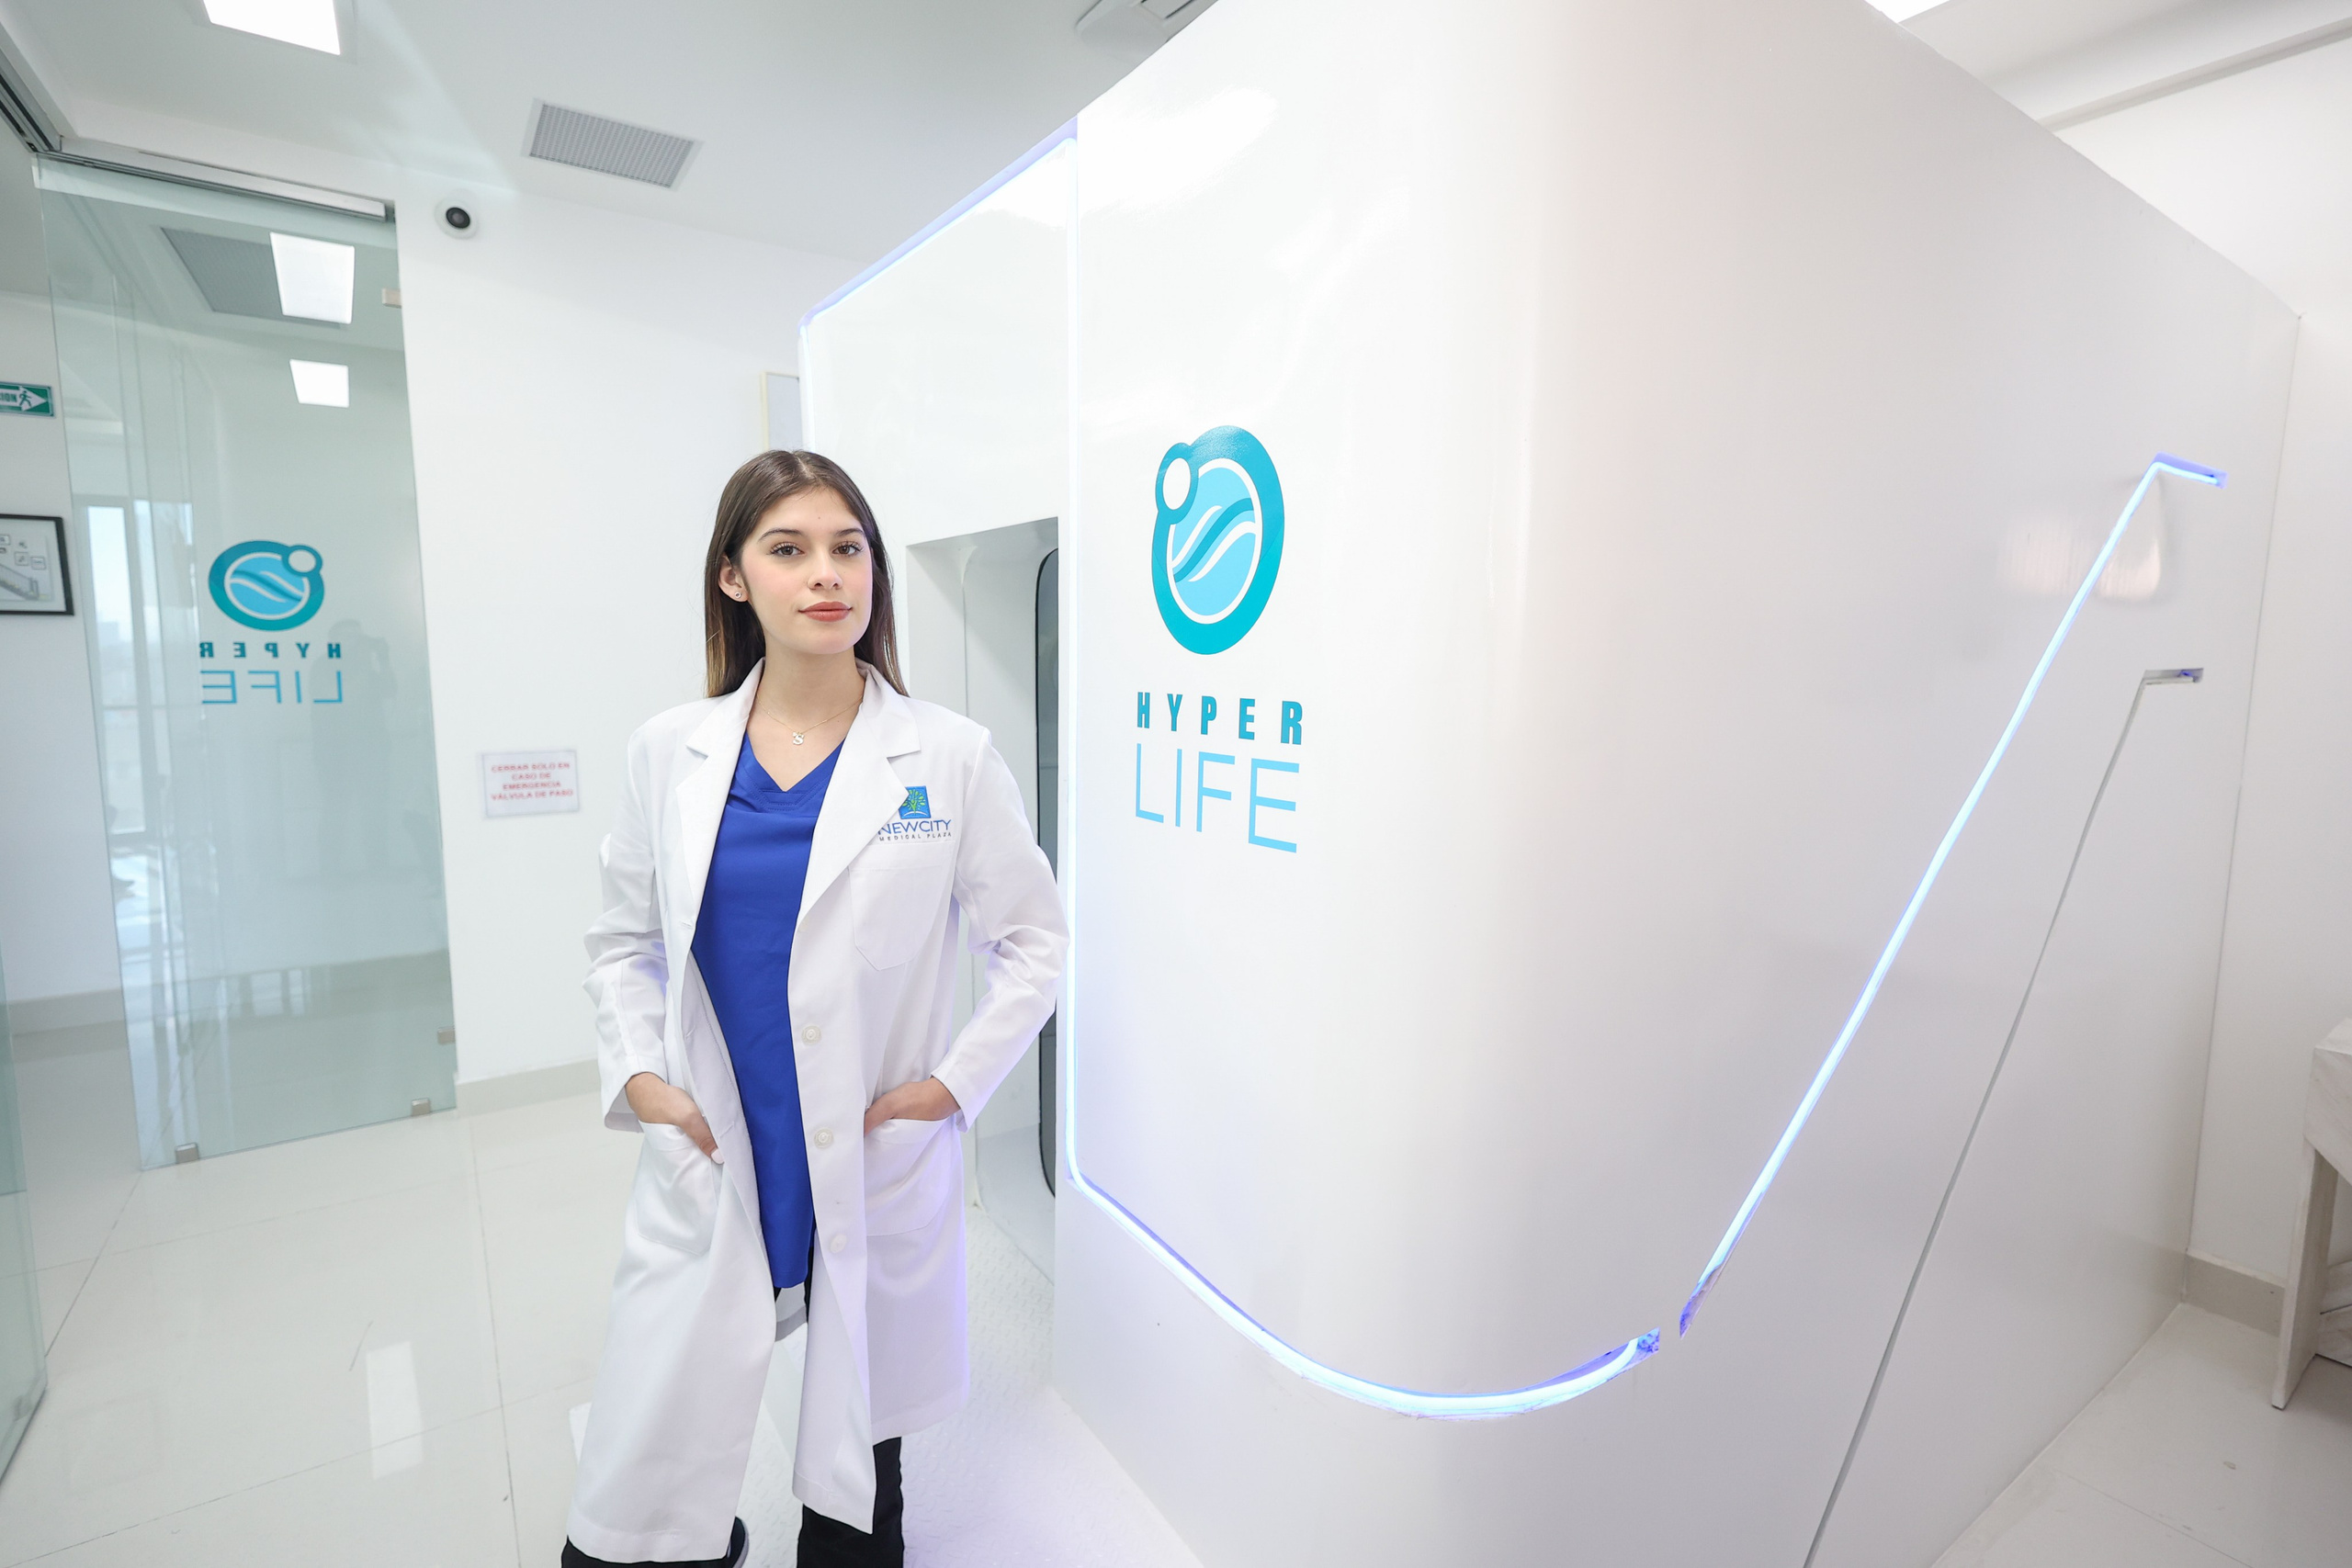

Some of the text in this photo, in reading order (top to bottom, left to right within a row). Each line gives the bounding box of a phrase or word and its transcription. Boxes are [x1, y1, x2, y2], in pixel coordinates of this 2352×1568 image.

[1136, 692, 1303, 745] HYPER
[492, 763, 528, 773] CERRAR
[512, 773, 537, 781] CASO
[503, 781, 561, 790] EMERGENCIA
[535, 790, 547, 798] DE
[548, 789, 573, 797] PASO
[1136, 743, 1300, 853] LIFE
[877, 819, 951, 835] NEWCITY
